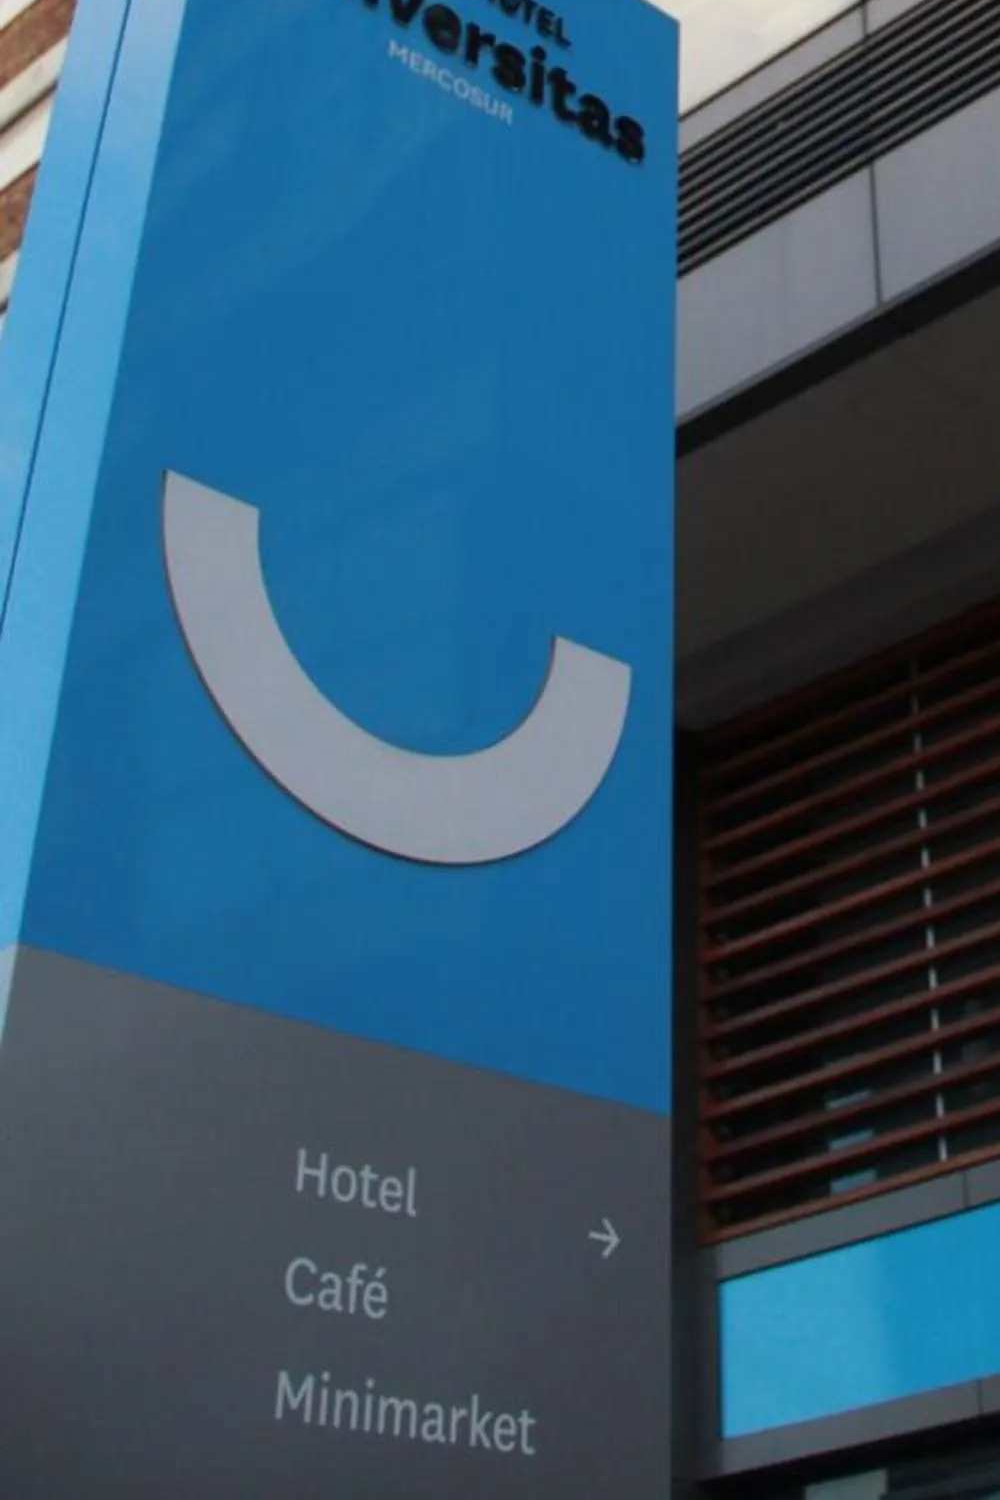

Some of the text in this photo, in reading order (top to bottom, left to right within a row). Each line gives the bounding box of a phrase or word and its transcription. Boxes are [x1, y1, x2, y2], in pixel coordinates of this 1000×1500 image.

[388, 39, 515, 126] MERCOSUR
[294, 1148, 417, 1217] Hotel
[284, 1257, 389, 1320] Café
[275, 1370, 536, 1455] Minimarket
